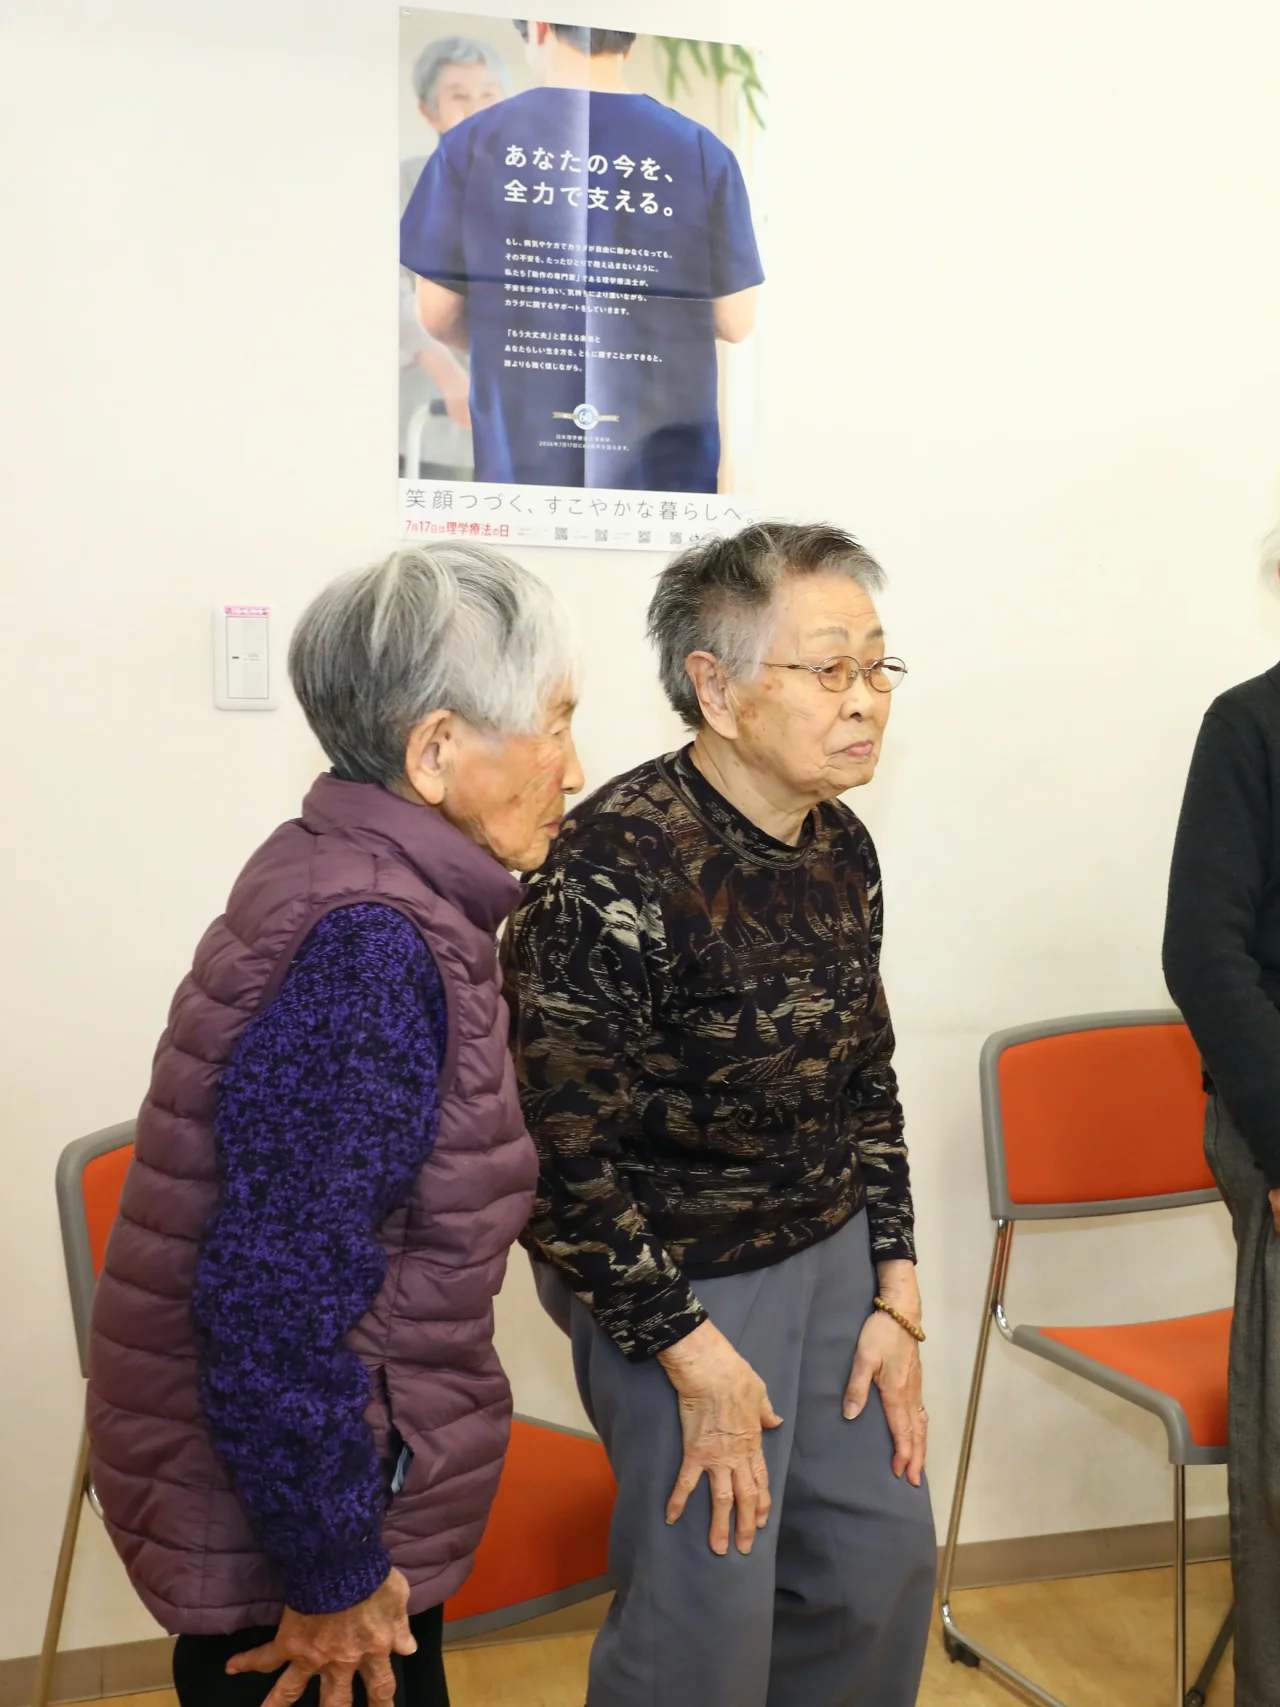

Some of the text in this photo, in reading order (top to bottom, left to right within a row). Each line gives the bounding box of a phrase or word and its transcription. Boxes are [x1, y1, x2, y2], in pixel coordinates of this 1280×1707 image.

[505, 144, 673, 183] あなたの今を、
[504, 179, 673, 217] 全力で支える。
[405, 488, 754, 524] 笑顔つづく、すこやかな暮らしへ。
[405, 520, 509, 538] 7月17日は理学療法の日
